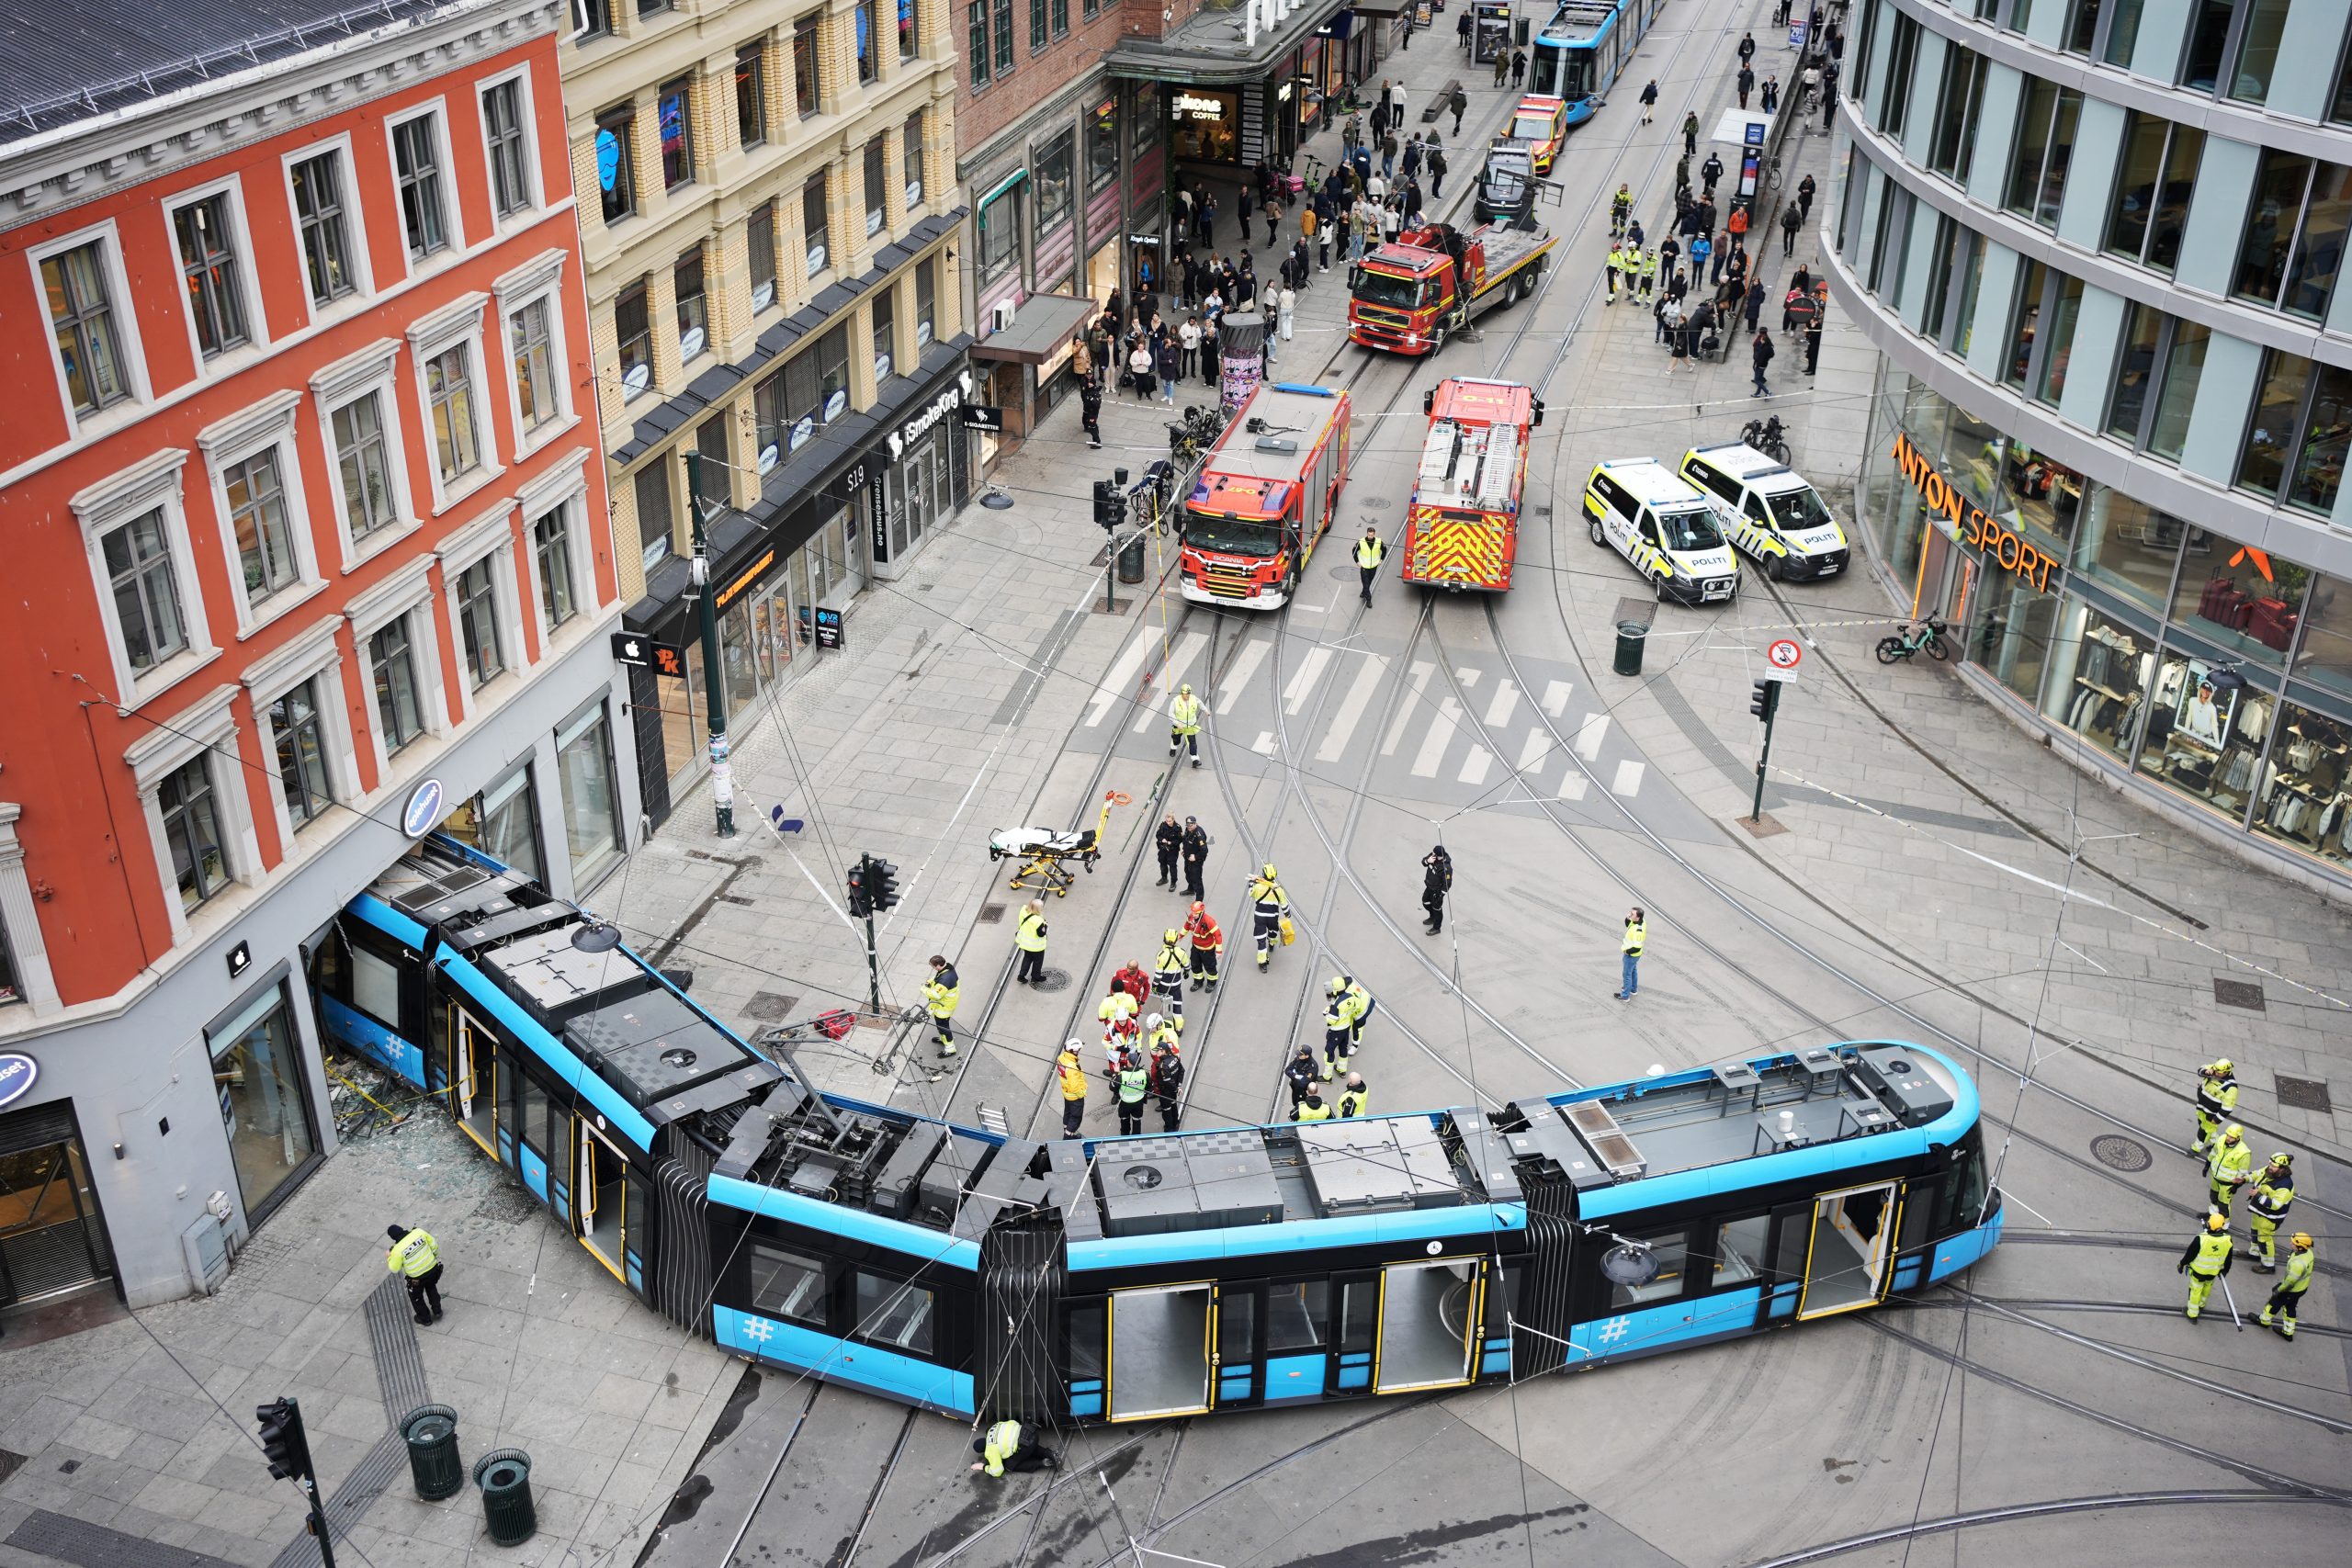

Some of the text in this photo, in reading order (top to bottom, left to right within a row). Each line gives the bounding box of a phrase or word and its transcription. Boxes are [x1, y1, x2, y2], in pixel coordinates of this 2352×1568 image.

[1192, 112, 1220, 120] COFFEE
[904, 388, 958, 446] iSmokeKing
[964, 422, 1000, 431] E-SIGARETTER
[847, 465, 864, 492] S19
[1227, 485, 1257, 495] O-67
[875, 477, 884, 547] Grensesnus.no
[1891, 432, 2059, 593] ANTON SPORT
[1610, 522, 1628, 544] POLITI
[1804, 533, 1837, 545] POLITI
[1437, 534, 1483, 553] O-11
[1213, 555, 1245, 565] SCANIA
[1691, 557, 1727, 567] POLITI
[827, 613, 839, 621] VR
[409, 785, 439, 828] eplehuset
[403, 1236, 424, 1256] POLITI
